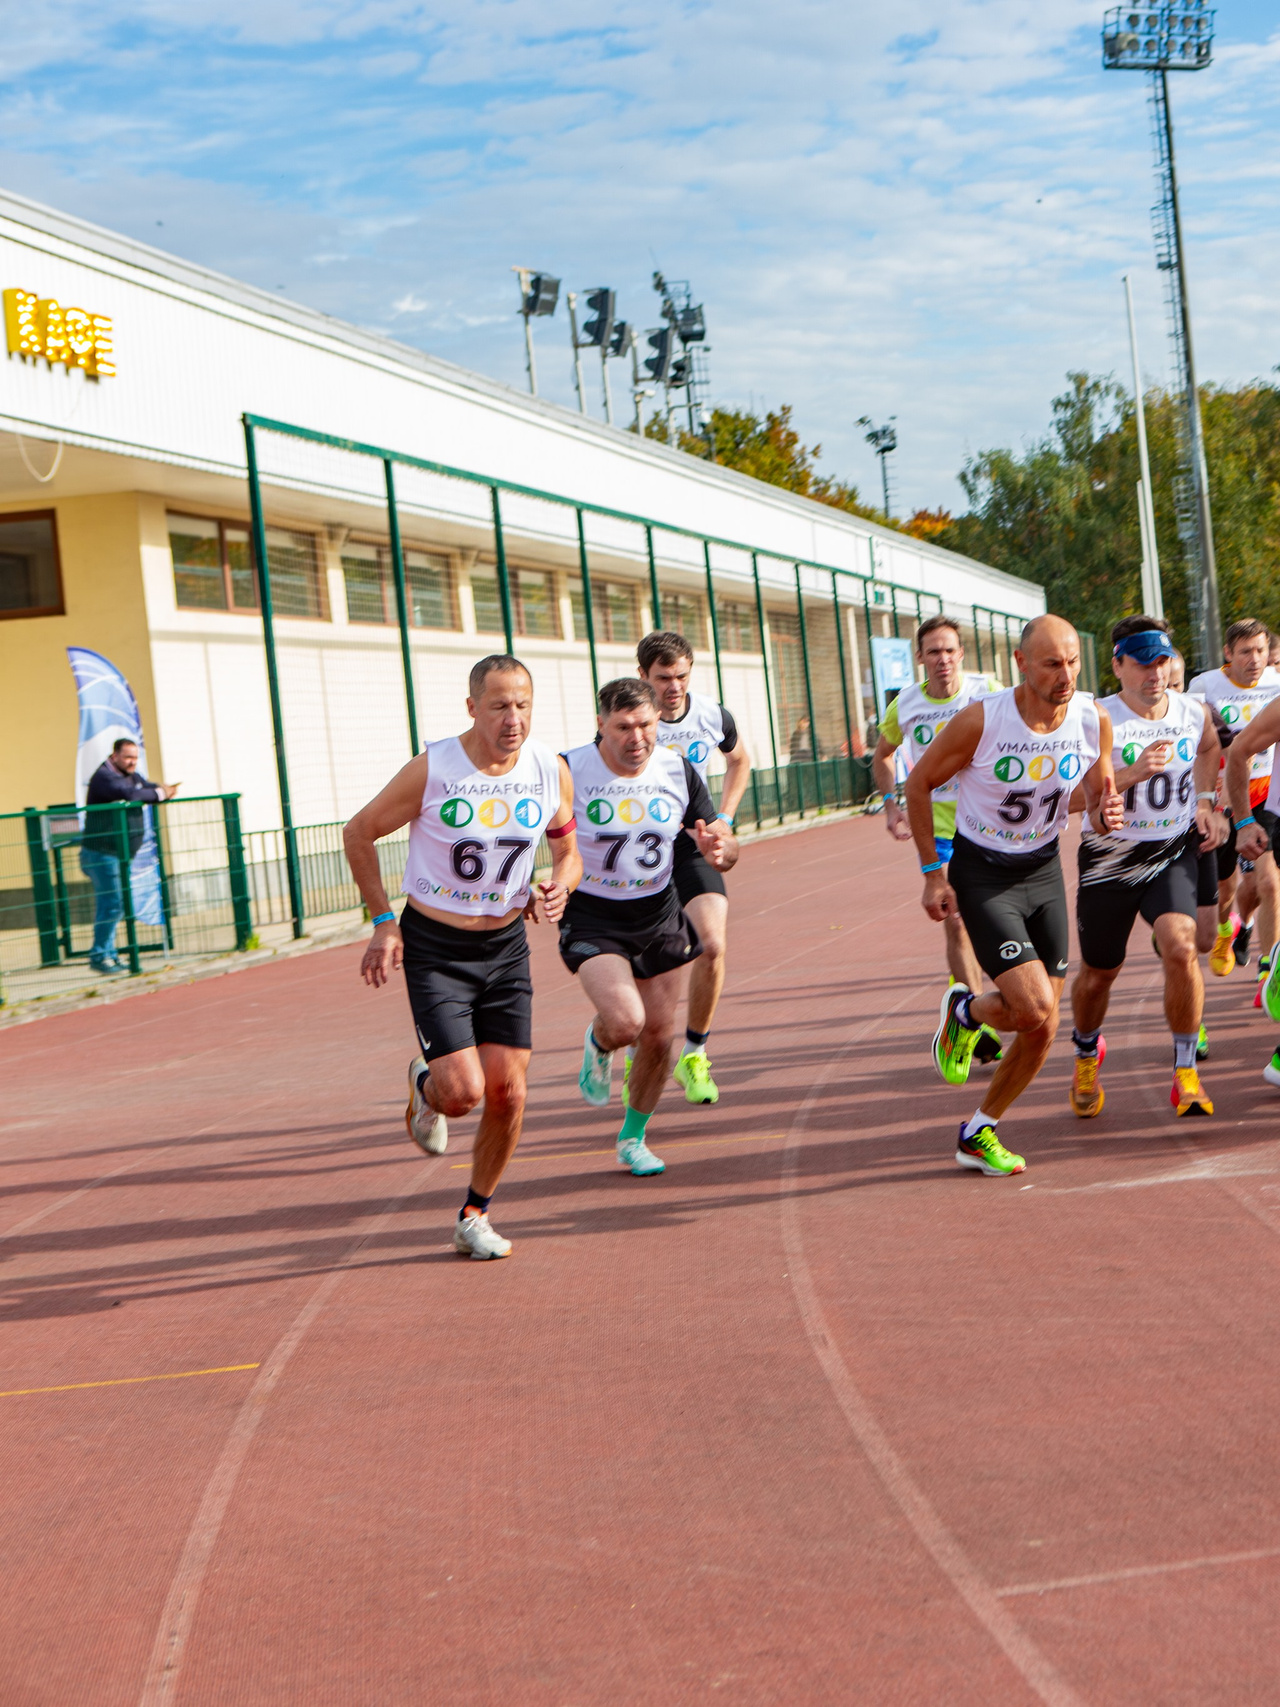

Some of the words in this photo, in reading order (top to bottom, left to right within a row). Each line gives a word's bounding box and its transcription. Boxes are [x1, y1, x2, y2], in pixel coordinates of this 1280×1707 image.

[996, 739, 1083, 753] VMARAFONE
[442, 782, 543, 796] VMARAFONE
[584, 784, 671, 797] VMARAFONE
[997, 786, 1067, 827] 51
[448, 836, 534, 885] 67
[594, 830, 665, 873] 73
